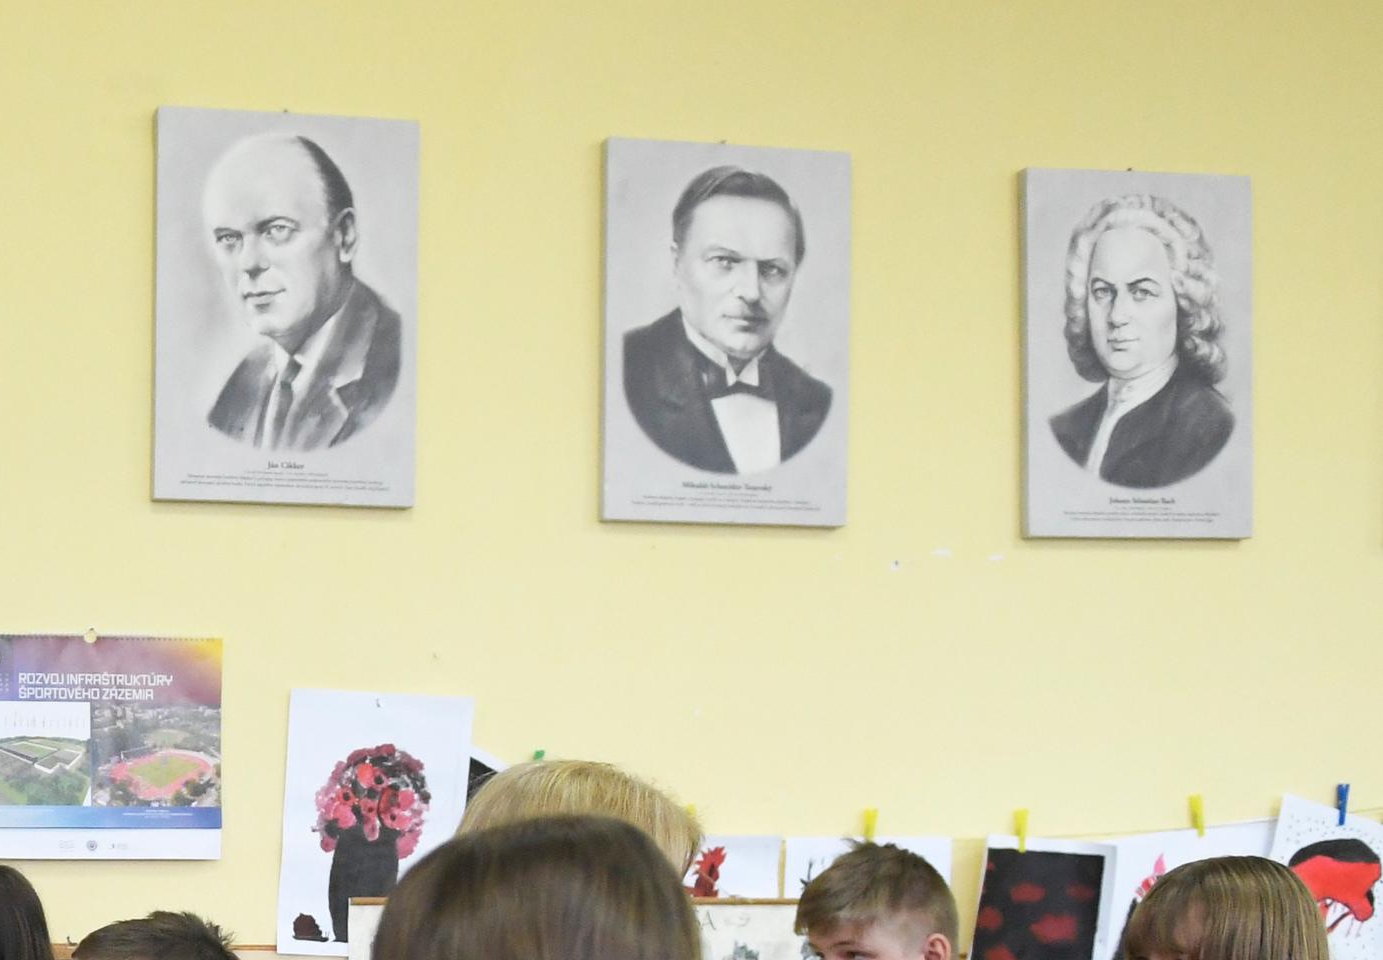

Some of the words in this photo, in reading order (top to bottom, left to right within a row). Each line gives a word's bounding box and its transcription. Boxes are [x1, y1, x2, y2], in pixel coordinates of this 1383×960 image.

[18, 673, 64, 685] ROZVOJ
[66, 672, 173, 686] INFRAŠTRUKTÚRY
[18, 685, 100, 699] ŠPORTOVÉHO
[102, 687, 154, 700] ZÁZEMIA
